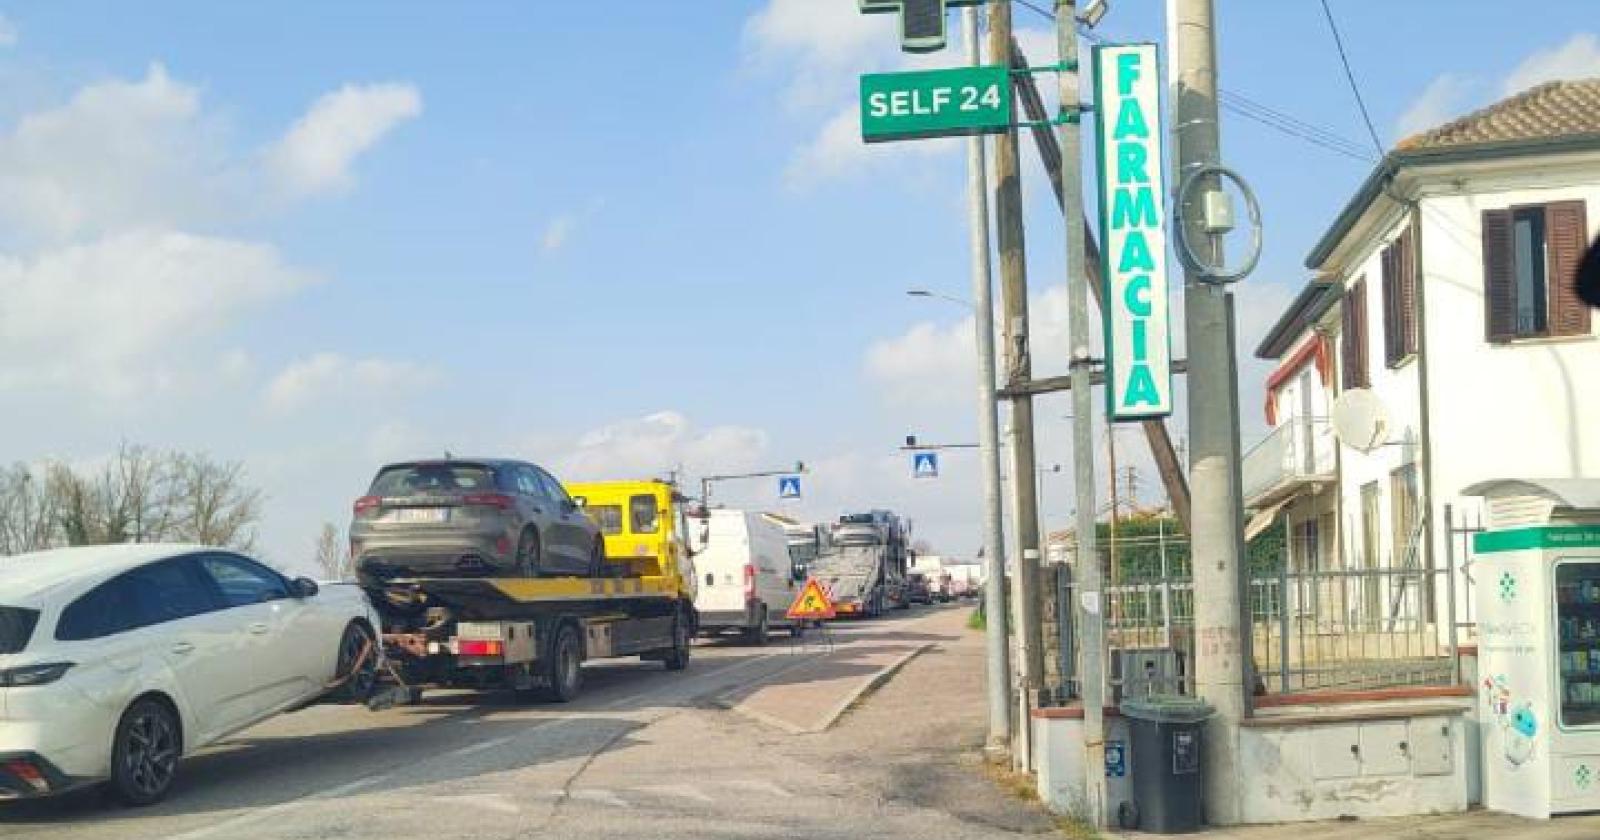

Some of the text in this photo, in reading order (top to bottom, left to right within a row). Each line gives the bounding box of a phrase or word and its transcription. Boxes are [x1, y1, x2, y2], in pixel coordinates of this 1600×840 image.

[870, 84, 1000, 117] SELF 24
[1113, 53, 1160, 407] FARMACIA
